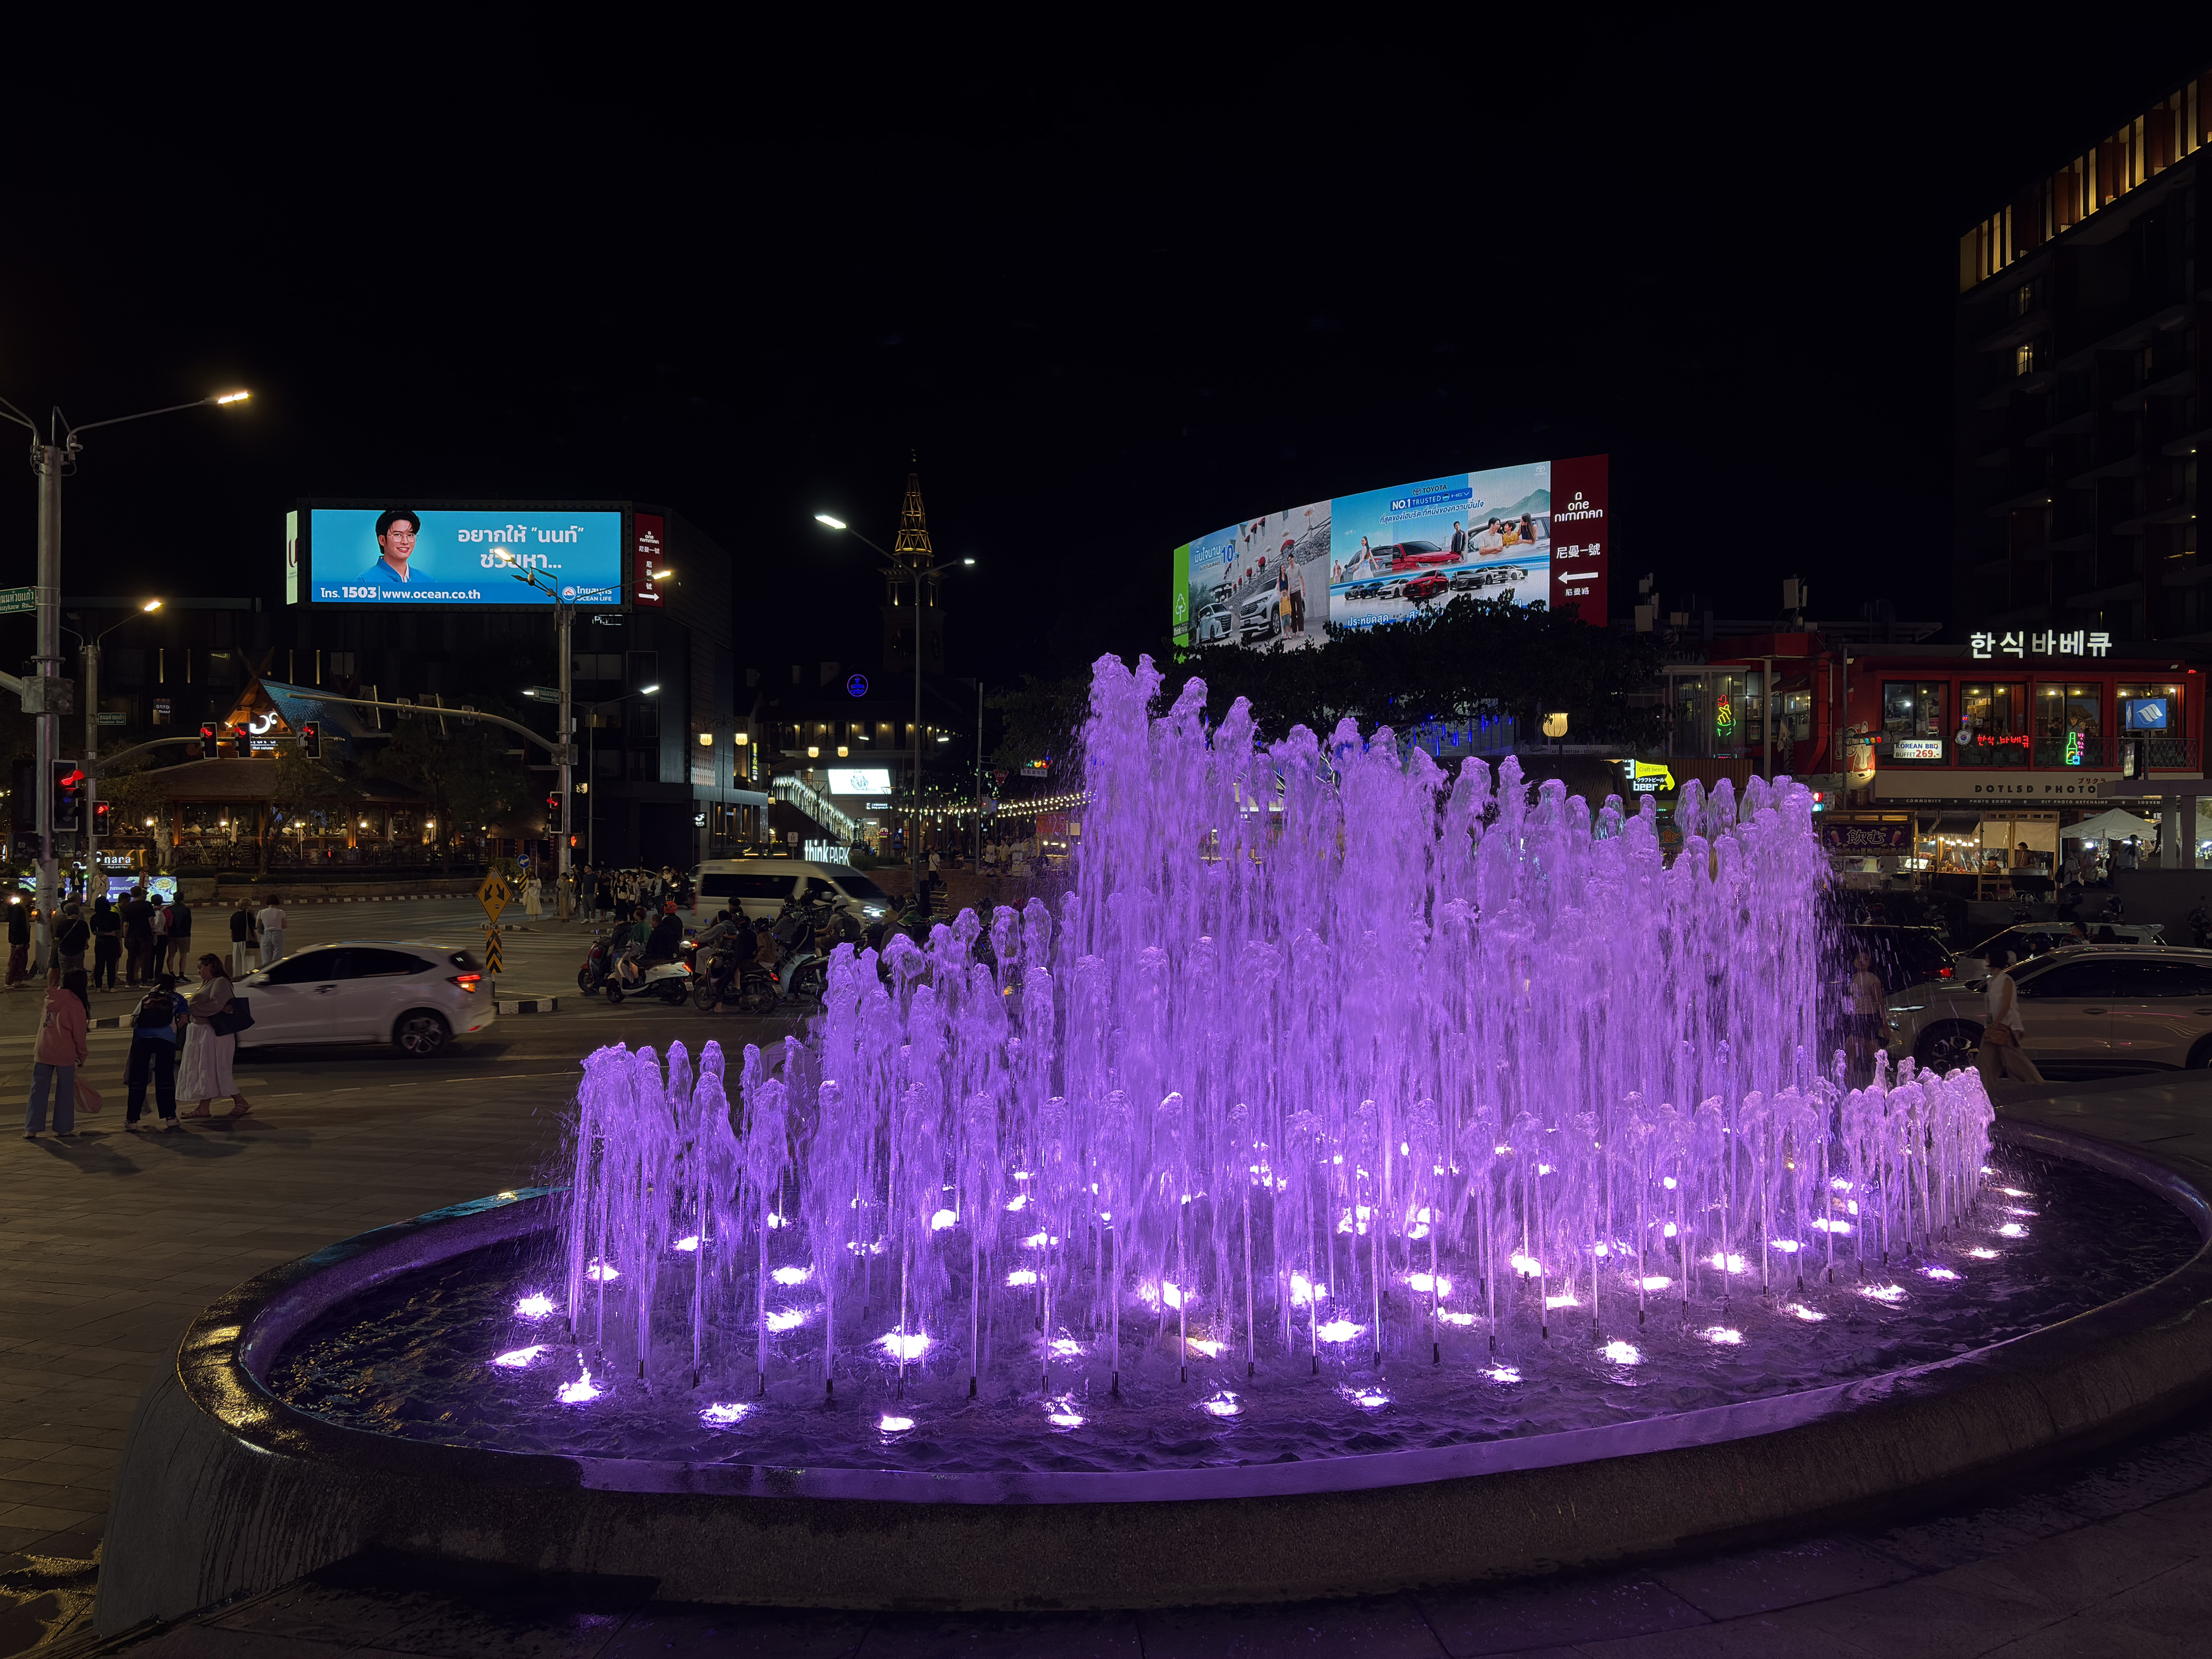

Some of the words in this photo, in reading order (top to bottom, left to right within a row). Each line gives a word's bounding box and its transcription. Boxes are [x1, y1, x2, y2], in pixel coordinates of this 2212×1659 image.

[1422, 484, 1447, 494] TOYOTA
[1392, 499, 1411, 510] NO.1
[1412, 495, 1441, 505] TRUSTED
[1568, 500, 1590, 511] one
[458, 524, 527, 542] อยากให้
[1221, 544, 1234, 564] 10
[1556, 543, 1601, 559] 尼曼一號
[0, 589, 34, 604] นนห้วยแก้ว
[342, 587, 377, 598] 1503
[382, 589, 481, 599] www.ocean.co.th
[1970, 631, 2024, 659] 한식
[2032, 629, 2112, 657] 바베큐
[1977, 734, 1995, 747] 한식
[1916, 749, 1939, 758] 269.-
[1633, 780, 1658, 791] beer
[1975, 785, 2034, 793] DOTLSD
[2045, 785, 2096, 794] PHOTO
[1846, 829, 1886, 846] 飲む
